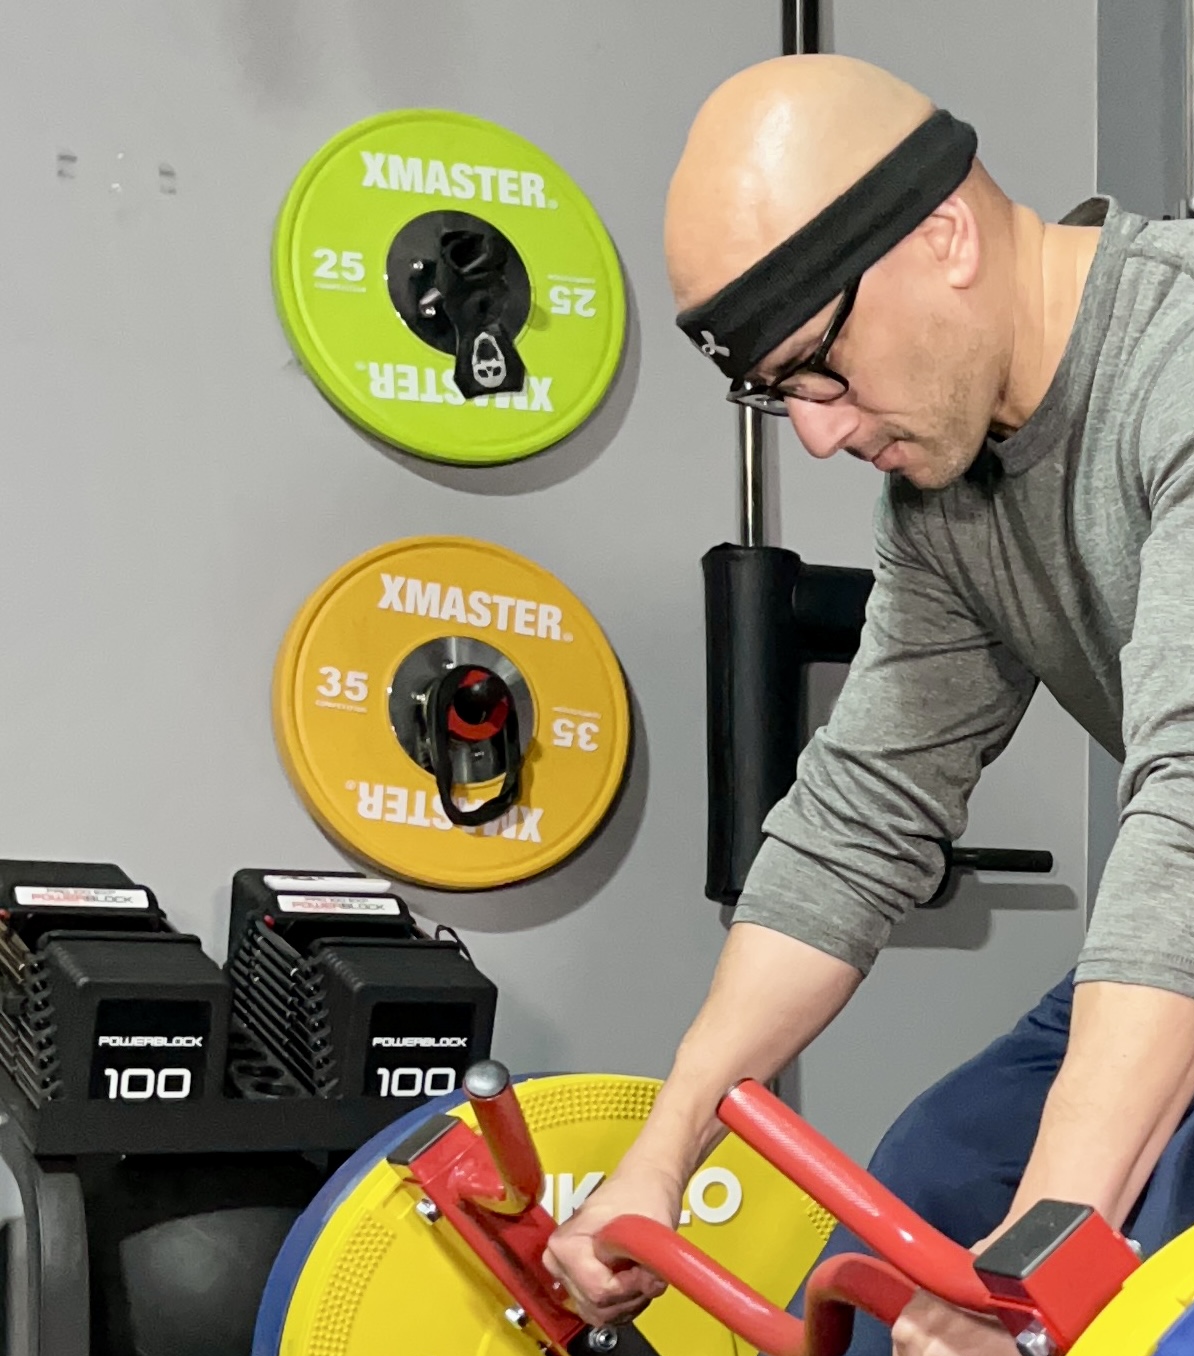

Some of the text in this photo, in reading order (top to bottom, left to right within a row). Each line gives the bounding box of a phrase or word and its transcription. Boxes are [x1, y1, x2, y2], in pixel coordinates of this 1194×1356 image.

[361, 151, 546, 208] XMASTER
[313, 248, 366, 281] 25
[548, 284, 597, 318] 25
[377, 573, 562, 641] XMASTER
[316, 666, 369, 702] 35
[551, 718, 600, 752] 35
[98, 1036, 203, 1047] POWERBLOCK
[372, 1037, 467, 1047] POWERBLOCK
[104, 1068, 191, 1099] 100
[376, 1067, 456, 1097] 100
